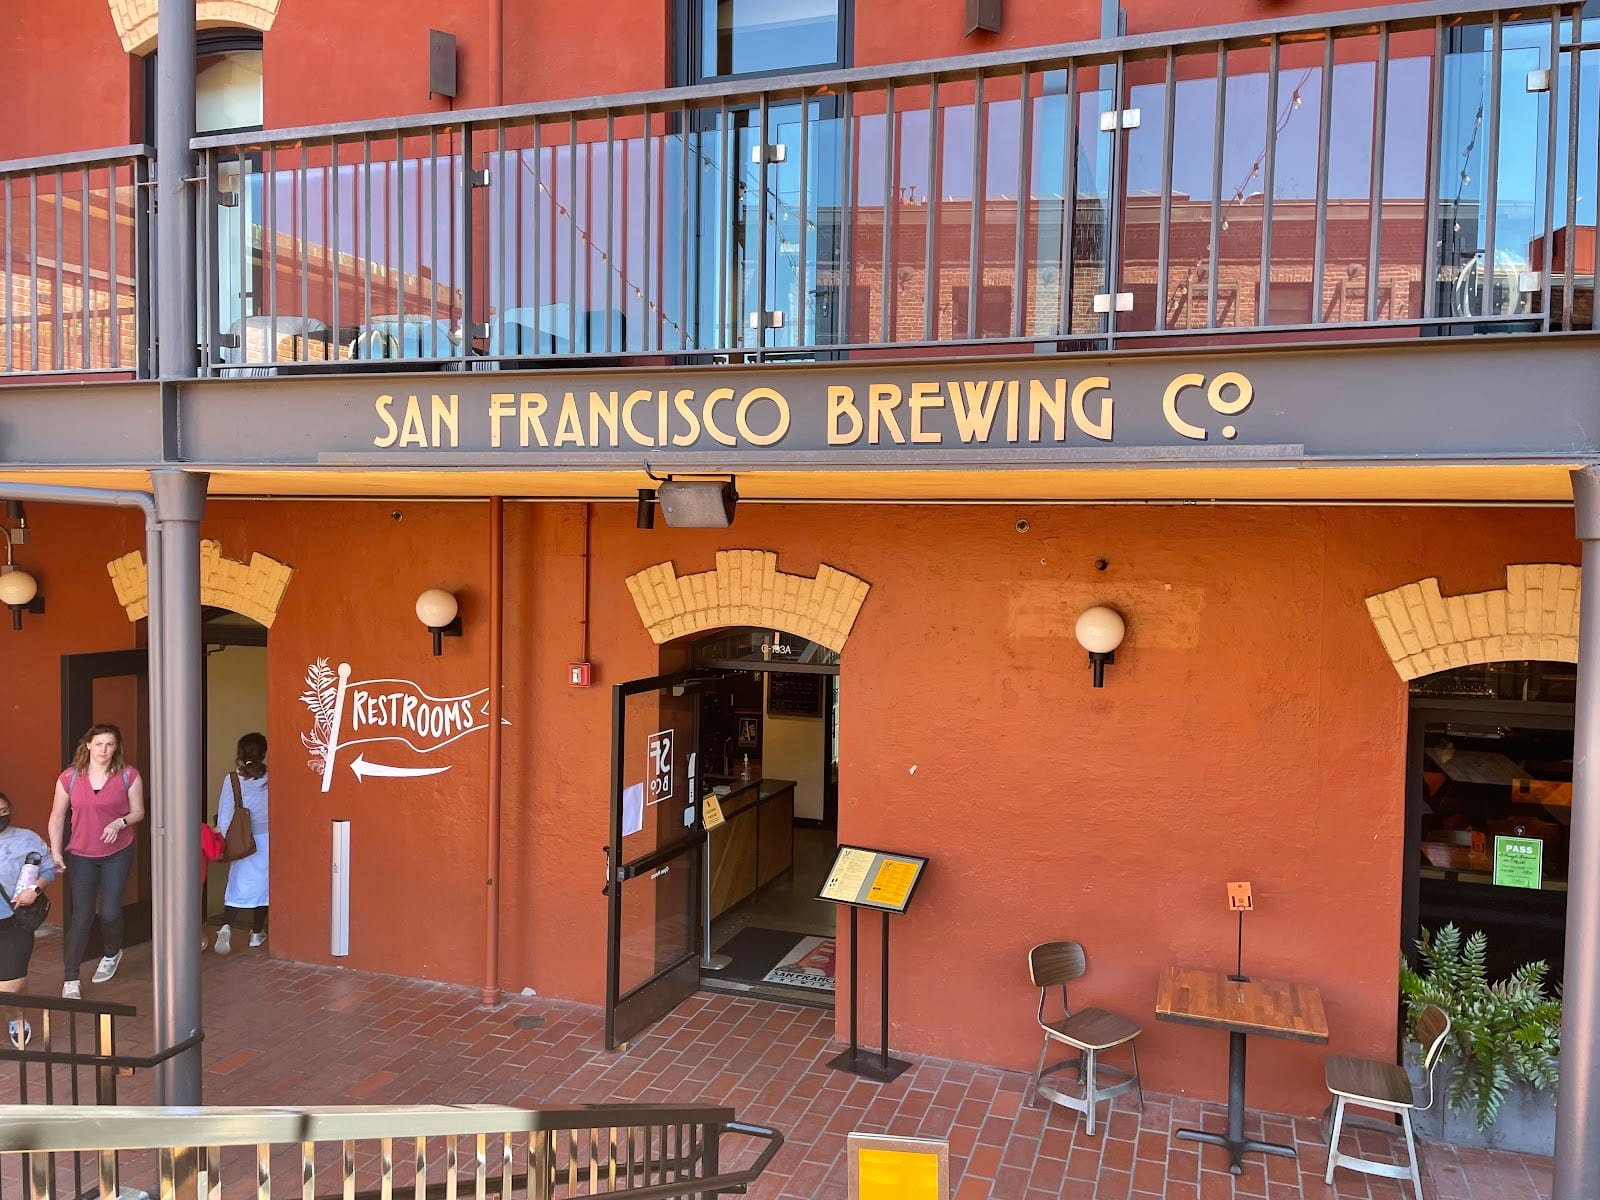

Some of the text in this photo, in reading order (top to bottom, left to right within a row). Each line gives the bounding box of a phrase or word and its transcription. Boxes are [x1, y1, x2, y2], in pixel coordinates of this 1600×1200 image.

[373, 394, 459, 447] SAN
[489, 387, 790, 446] FRANCISCO
[827, 377, 1113, 445] BREWING
[352, 689, 474, 738] RESTROOMS
[1505, 844, 1533, 854] PASS
